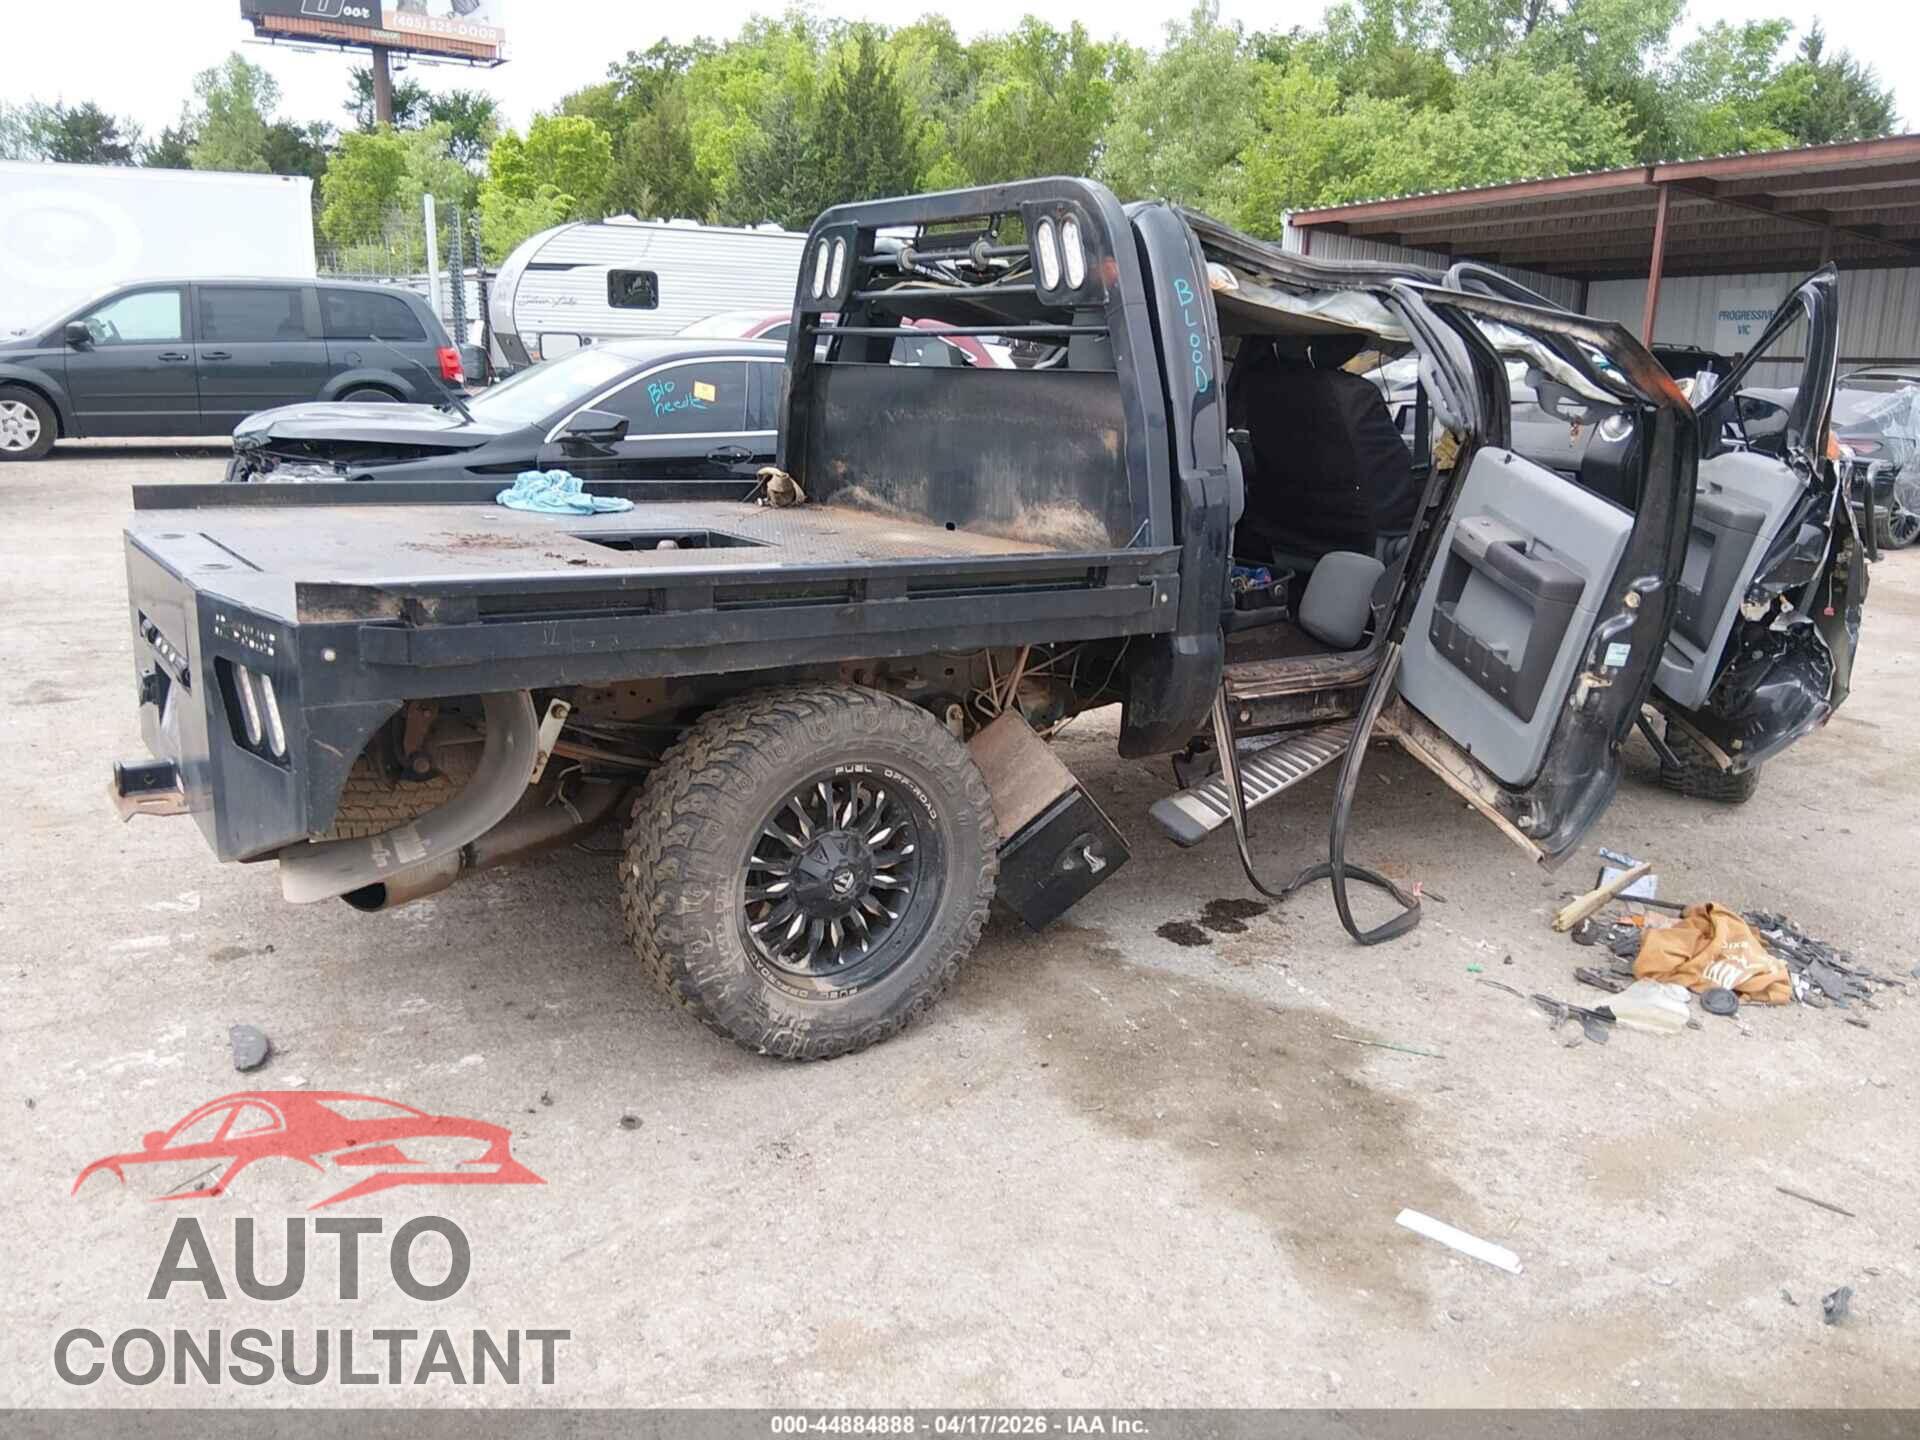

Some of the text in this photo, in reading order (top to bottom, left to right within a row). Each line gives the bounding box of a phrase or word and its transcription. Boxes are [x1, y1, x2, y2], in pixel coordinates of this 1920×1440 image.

[1174, 279, 1208, 393] BLOOD
[835, 764, 937, 820] FUEL OFF-ROAD
